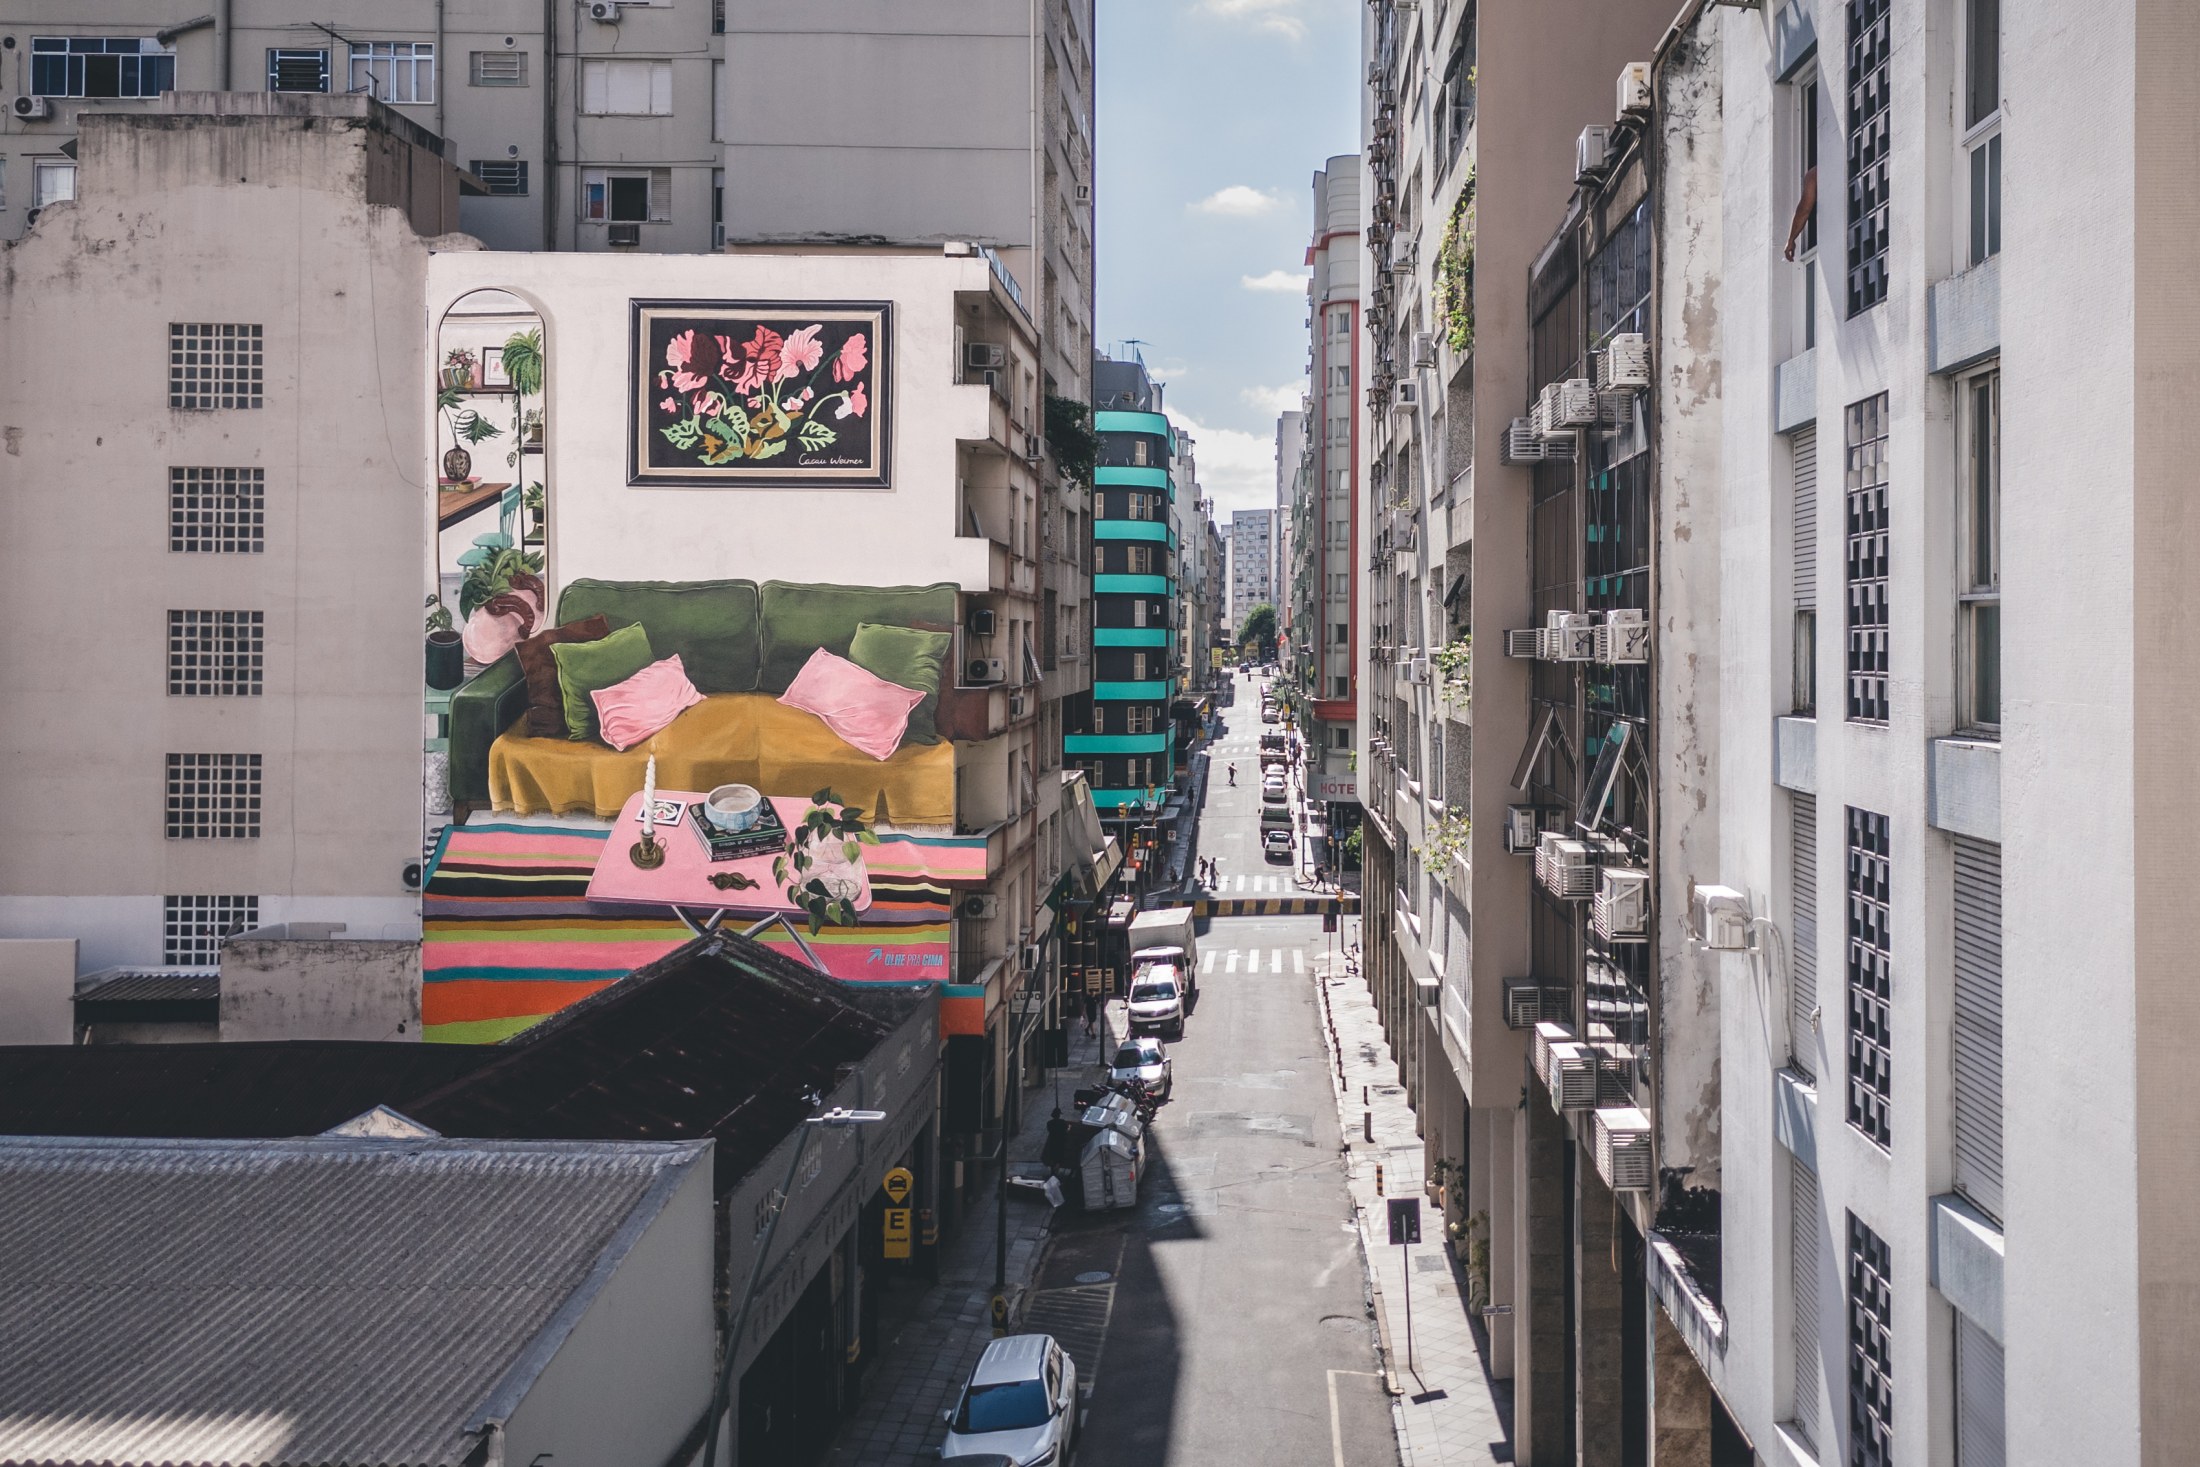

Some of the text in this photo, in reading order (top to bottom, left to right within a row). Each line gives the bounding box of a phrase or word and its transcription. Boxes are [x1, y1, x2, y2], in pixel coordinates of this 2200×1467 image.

[798, 452, 827, 465] Cacau
[1320, 782, 1357, 794] HOTE
[884, 953, 943, 966] OLHE PRA CIMA
[890, 1212, 905, 1230] E
